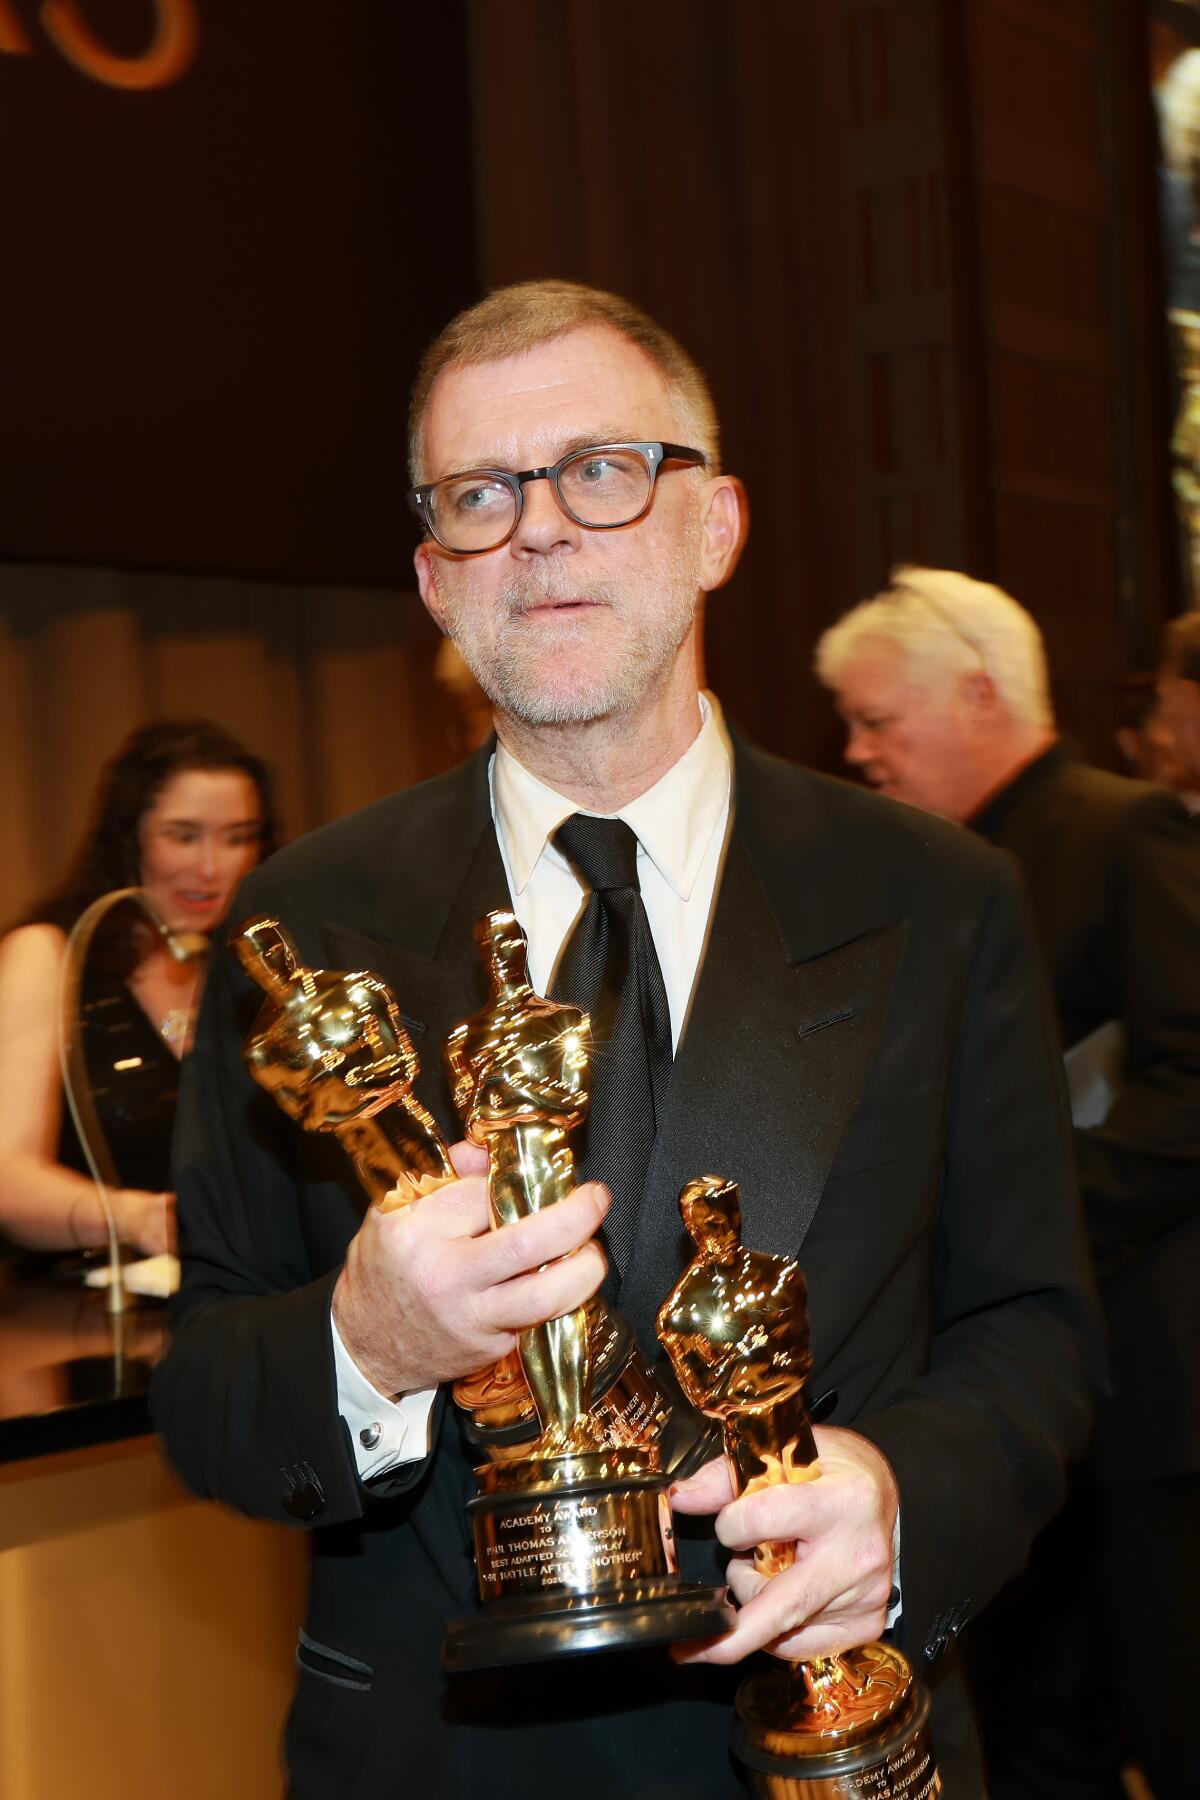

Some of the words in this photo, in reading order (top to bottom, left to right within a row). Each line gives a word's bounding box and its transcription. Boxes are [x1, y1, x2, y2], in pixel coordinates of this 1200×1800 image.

[628, 1401, 647, 1426] 2025
[500, 1512, 551, 1529] ACADEMY
[553, 1506, 598, 1521] AWARD
[539, 1525, 552, 1534] TO
[508, 1537, 555, 1553] THOMAS
[558, 1526, 627, 1545] ANERSON
[491, 1558, 509, 1568] BEST
[510, 1552, 554, 1565] ADAPTED
[832, 1768, 886, 1793] ACADEMY
[886, 1748, 917, 1774] AWARD
[892, 1753, 931, 1795] ANDERSON
[875, 1780, 888, 1789] TO
